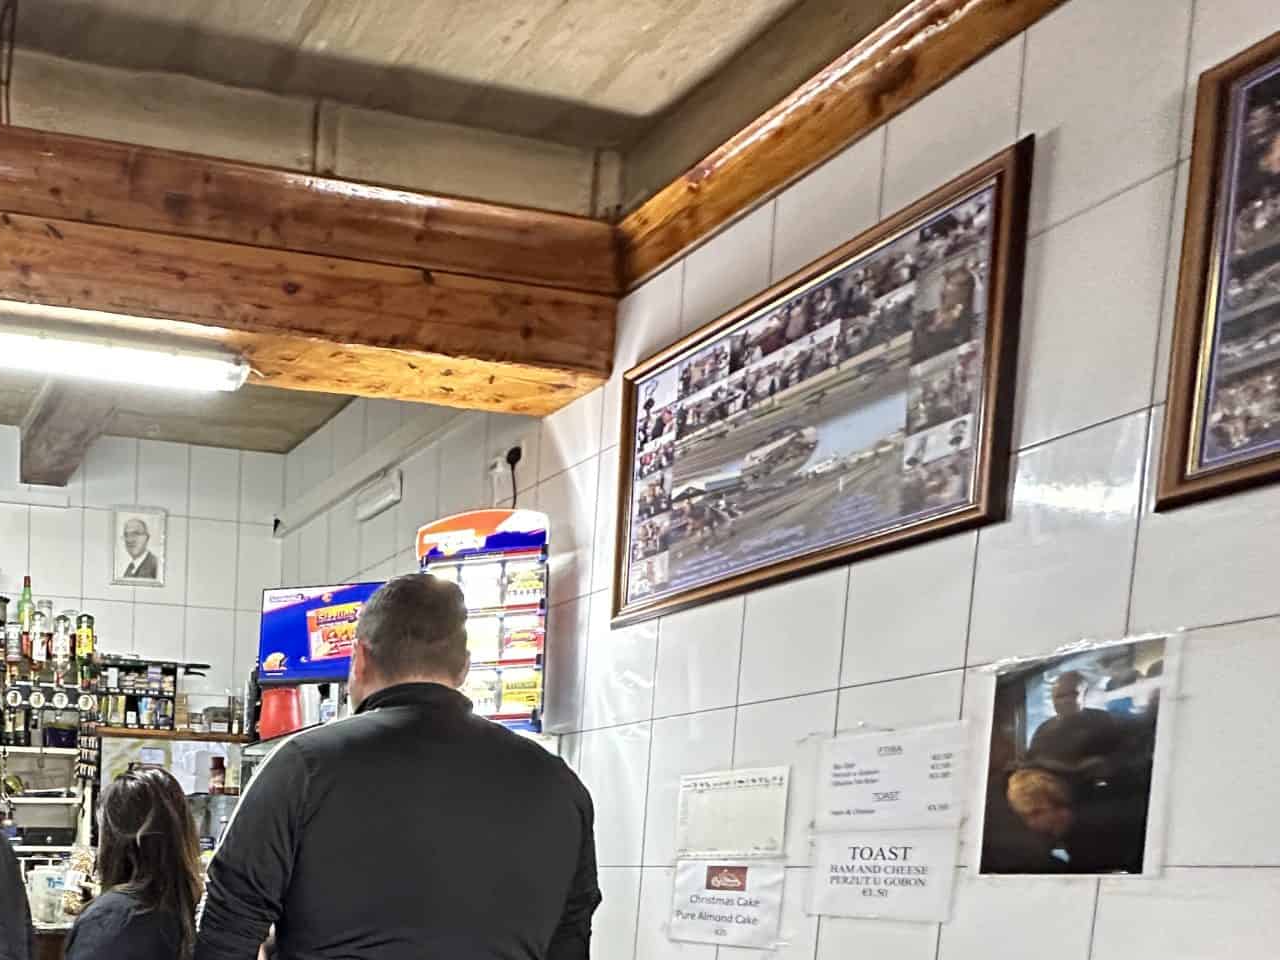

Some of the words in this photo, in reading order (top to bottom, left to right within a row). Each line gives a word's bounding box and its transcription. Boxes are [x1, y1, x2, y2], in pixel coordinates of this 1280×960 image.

[848, 846, 912, 861] TOAST
[830, 864, 854, 873] HAM
[857, 865, 881, 874] AND
[883, 865, 928, 875] CHEESE
[690, 894, 735, 906] Christmas
[737, 897, 761, 907] Cake
[676, 910, 696, 921] Pure
[698, 911, 733, 923] Almond
[735, 914, 759, 925] Cake
